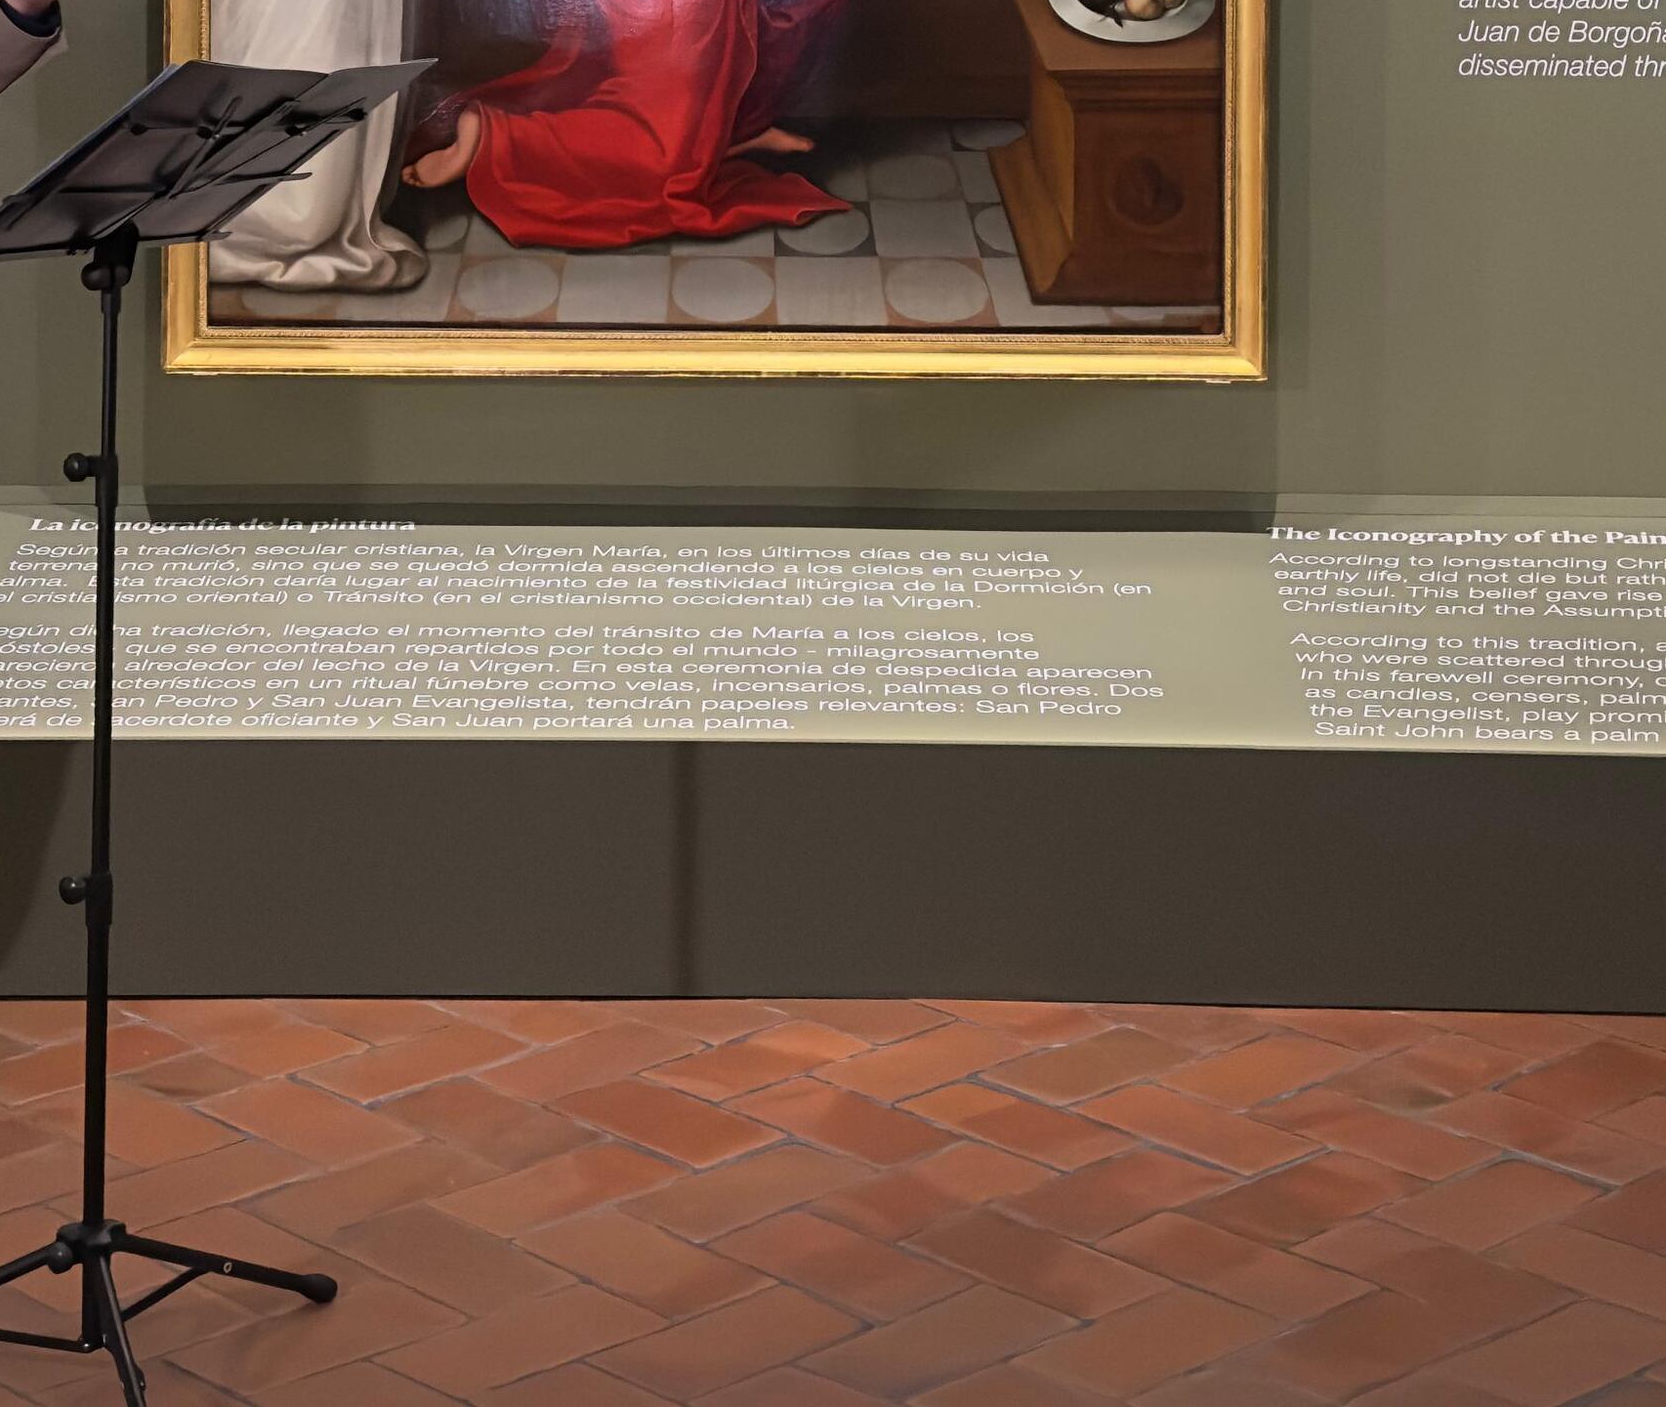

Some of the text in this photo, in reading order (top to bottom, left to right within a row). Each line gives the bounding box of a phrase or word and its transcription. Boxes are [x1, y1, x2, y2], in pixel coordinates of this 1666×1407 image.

[1458, 52, 1628, 78] disseminated
[28, 516, 418, 536] La icnografía de la pintura
[1266, 526, 1322, 541] The
[1327, 527, 1509, 547] Iconography
[1513, 529, 1547, 544] of
[1550, 529, 1598, 544] the
[16, 542, 99, 559] Según
[137, 543, 247, 556] tradición
[254, 543, 349, 556] secular
[353, 544, 465, 558] cristiana,
[475, 544, 496, 557] la
[504, 544, 583, 560] Virgen
[592, 545, 668, 560] María,
[677, 548, 709, 558] en
[717, 546, 753, 558] los
[761, 546, 851, 559] últimos
[859, 547, 911, 561] días
[919, 549, 951, 561] de
[959, 551, 989, 562] su
[996, 550, 1050, 563] vida
[1282, 599, 1428, 617] Christianity
[1434, 602, 1485, 616] and
[1492, 602, 1536, 616] the
[46, 711, 83, 727] de
[90, 711, 233, 727] acerdote
[240, 711, 359, 727] oficiante
[366, 715, 384, 731] y
[391, 711, 446, 727] San
[455, 712, 524, 728] Juan
[532, 712, 634, 732] portará
[643, 717, 696, 730] una
[703, 715, 796, 733] palma.
[1314, 721, 1386, 739] Saint
[1394, 723, 1464, 739] John
[1475, 725, 1554, 741] bears
[1563, 729, 1582, 741] a
[1590, 727, 1660, 746] palm
